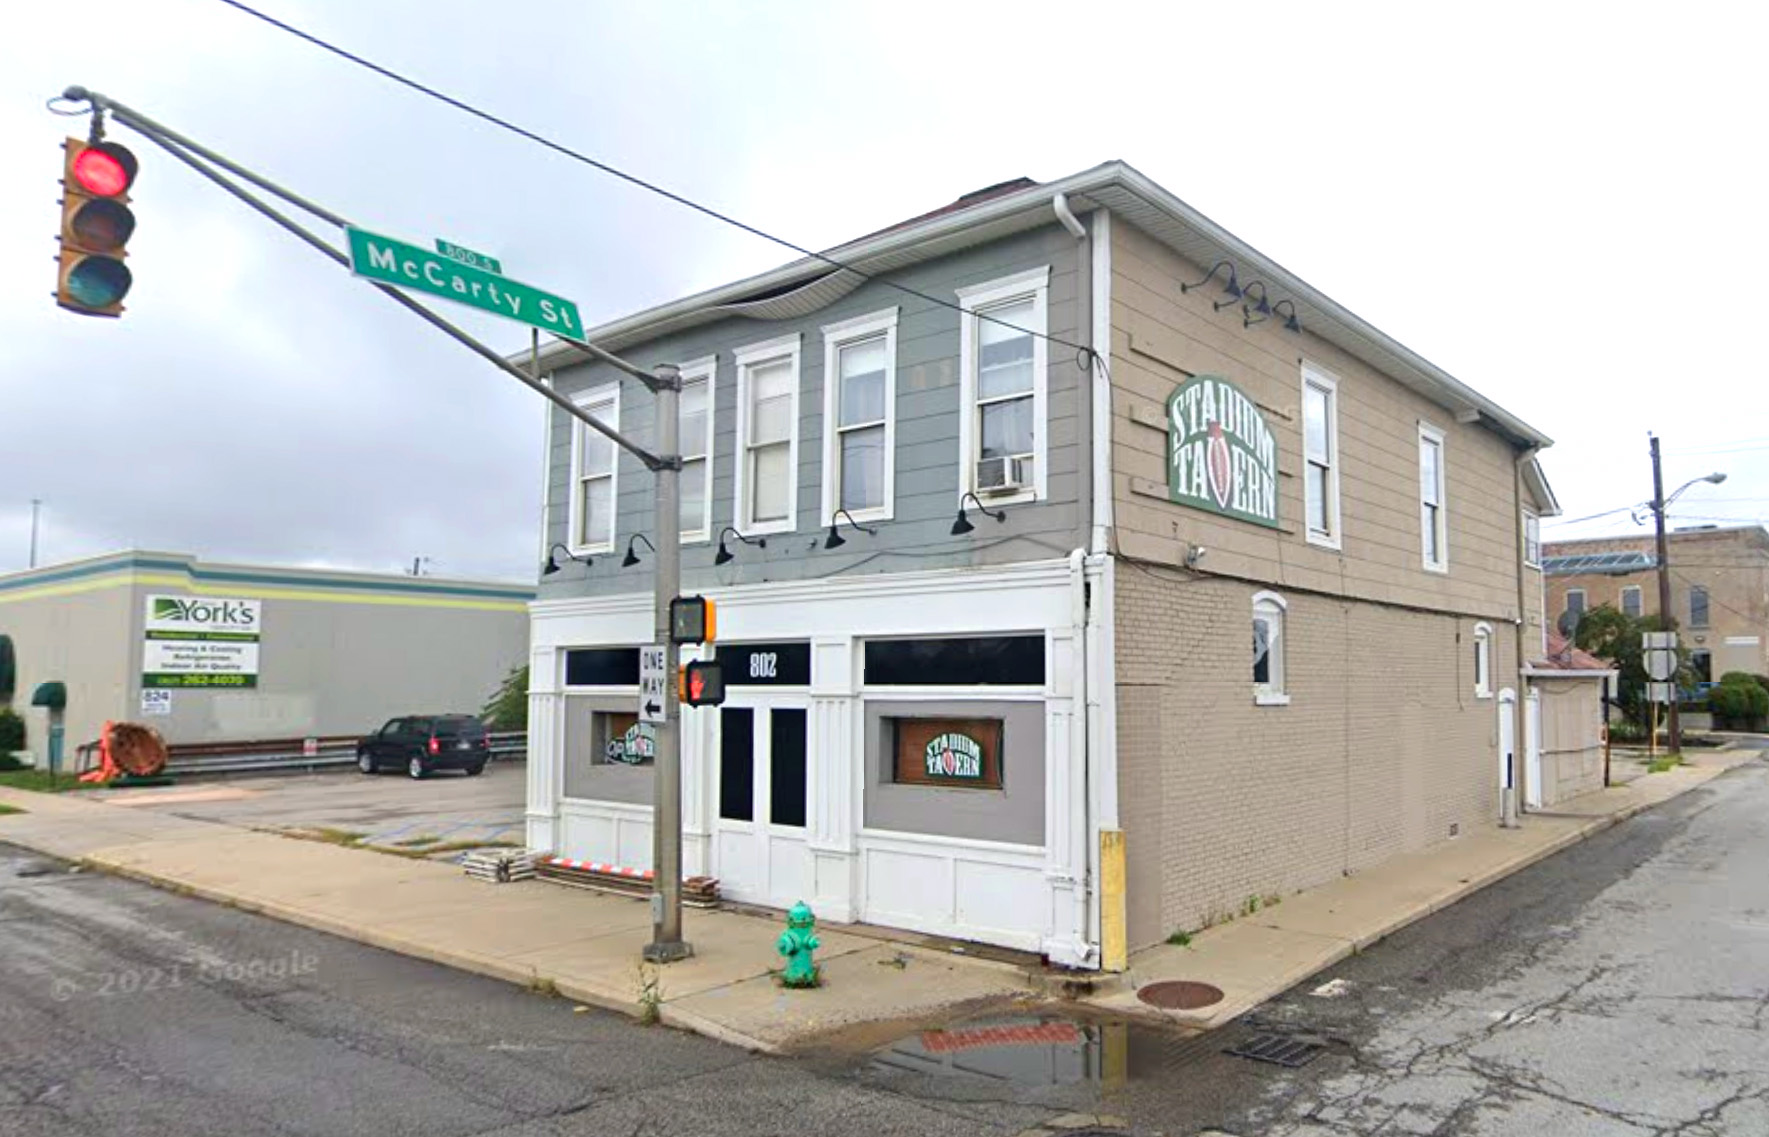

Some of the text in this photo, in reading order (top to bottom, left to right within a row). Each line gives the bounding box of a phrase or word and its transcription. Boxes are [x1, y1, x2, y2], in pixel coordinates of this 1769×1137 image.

[366, 241, 574, 329] McCarty St
[1172, 379, 1275, 478] STADIUM
[1173, 437, 1276, 520] TAVERN
[177, 599, 254, 625] York's
[643, 651, 664, 670] ONE
[750, 652, 777, 678] 802
[643, 677, 665, 696] WAY
[926, 733, 981, 760] STADIUM
[926, 750, 980, 776] TAVERN
